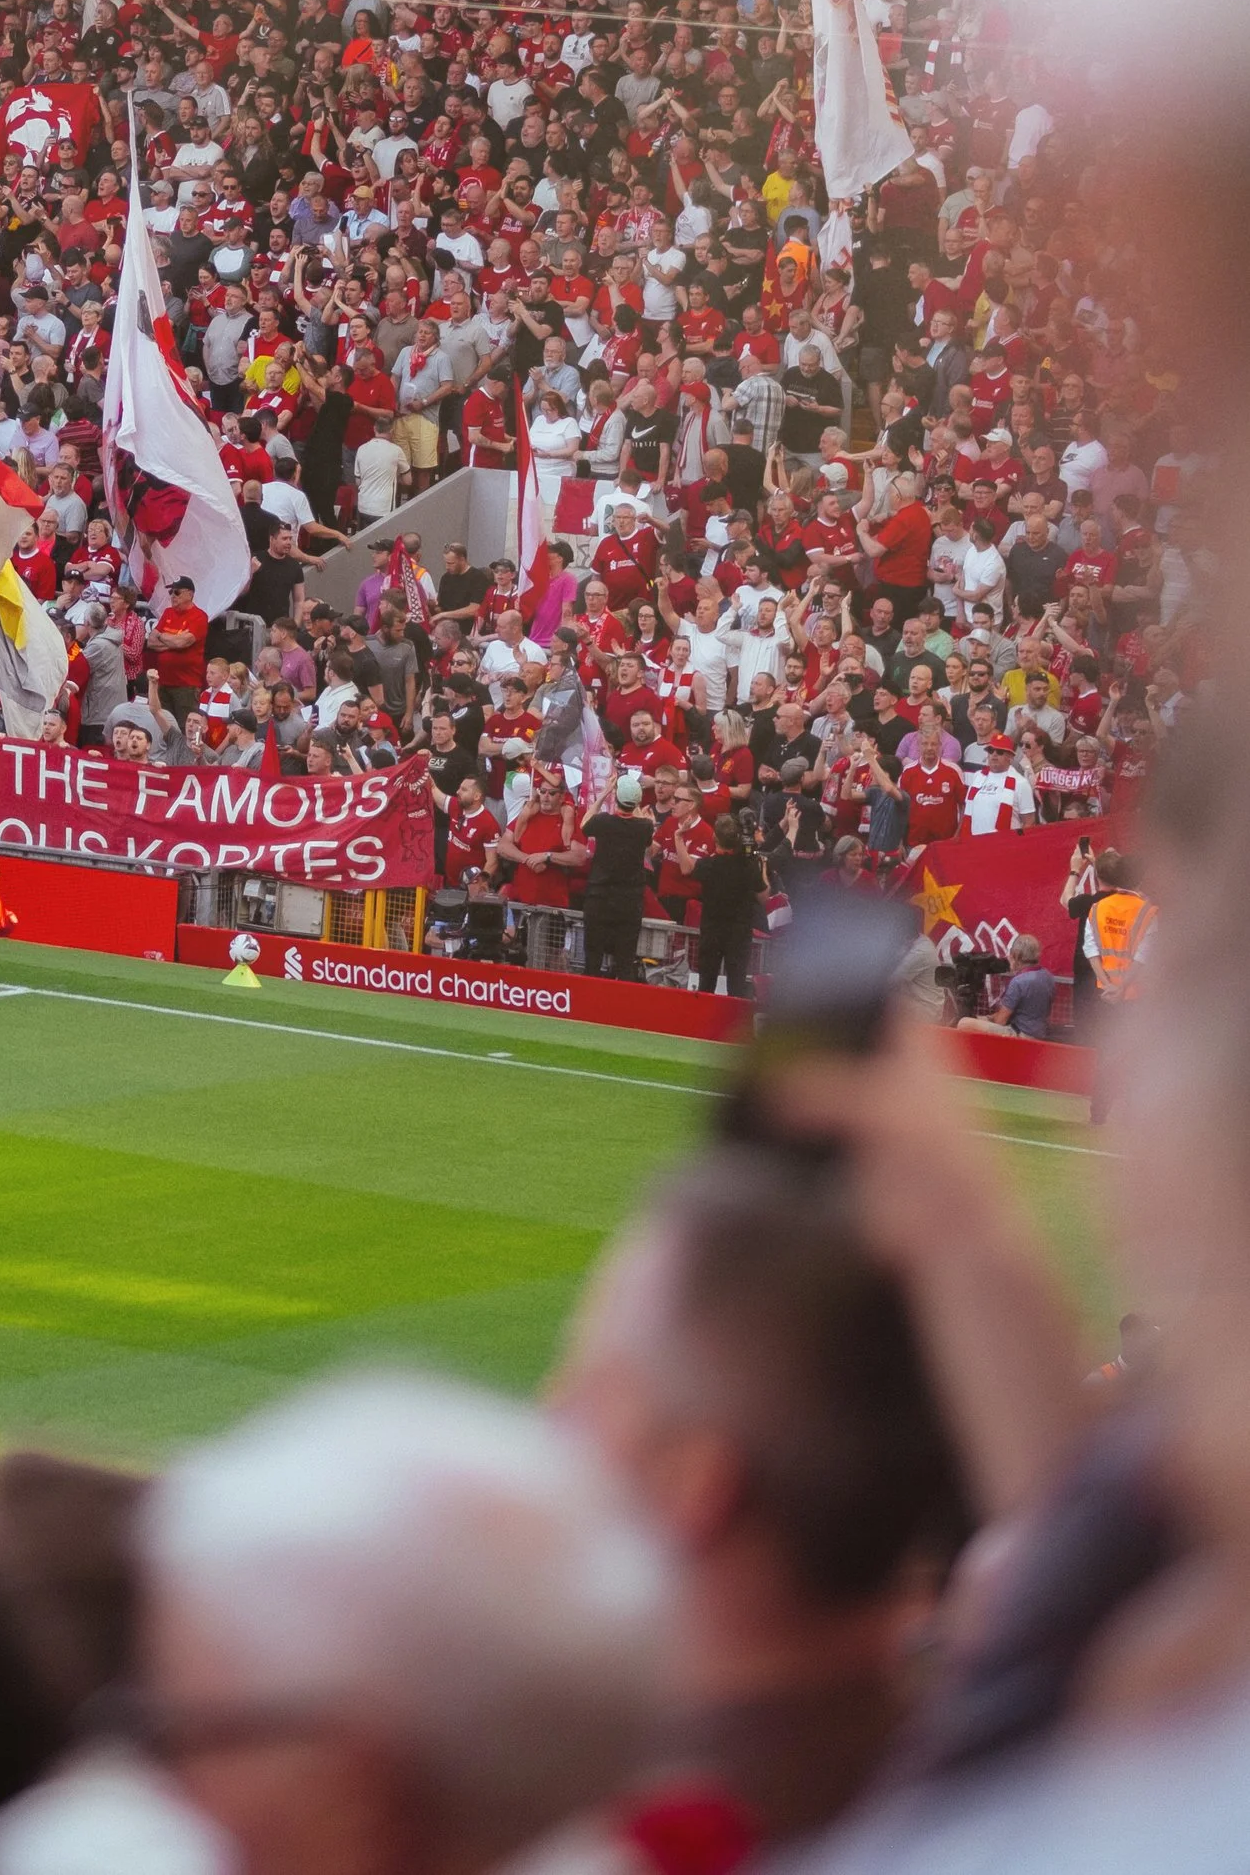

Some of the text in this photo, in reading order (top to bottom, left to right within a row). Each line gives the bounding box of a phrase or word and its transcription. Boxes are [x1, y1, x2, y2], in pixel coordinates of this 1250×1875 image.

[131, 770, 389, 828] FAMOUS
[312, 955, 571, 1013] standard chartered
